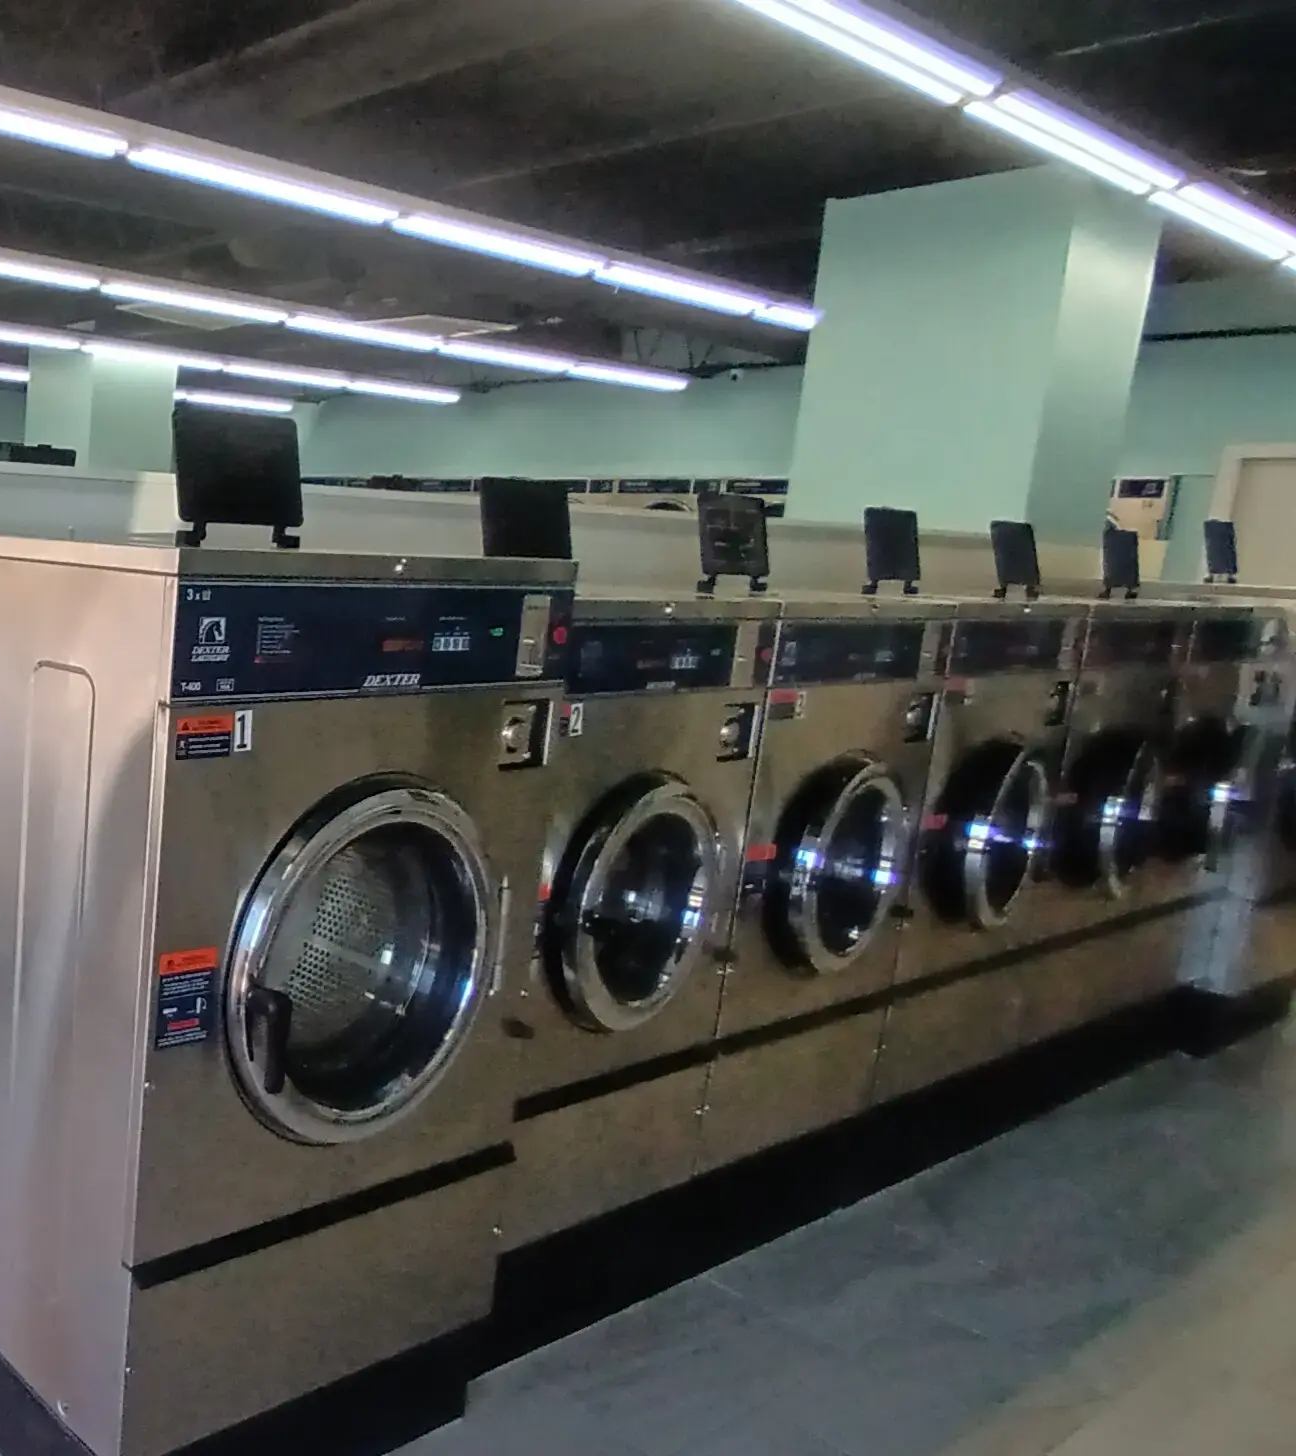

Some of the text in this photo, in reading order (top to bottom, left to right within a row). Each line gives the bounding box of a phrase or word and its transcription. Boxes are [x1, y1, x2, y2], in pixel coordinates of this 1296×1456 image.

[186, 589, 193, 601] 3
[191, 646, 230, 654] DEXTER
[362, 673, 421, 687] DEXTER
[572, 707, 580, 733] 2
[237, 713, 248, 749] 1
